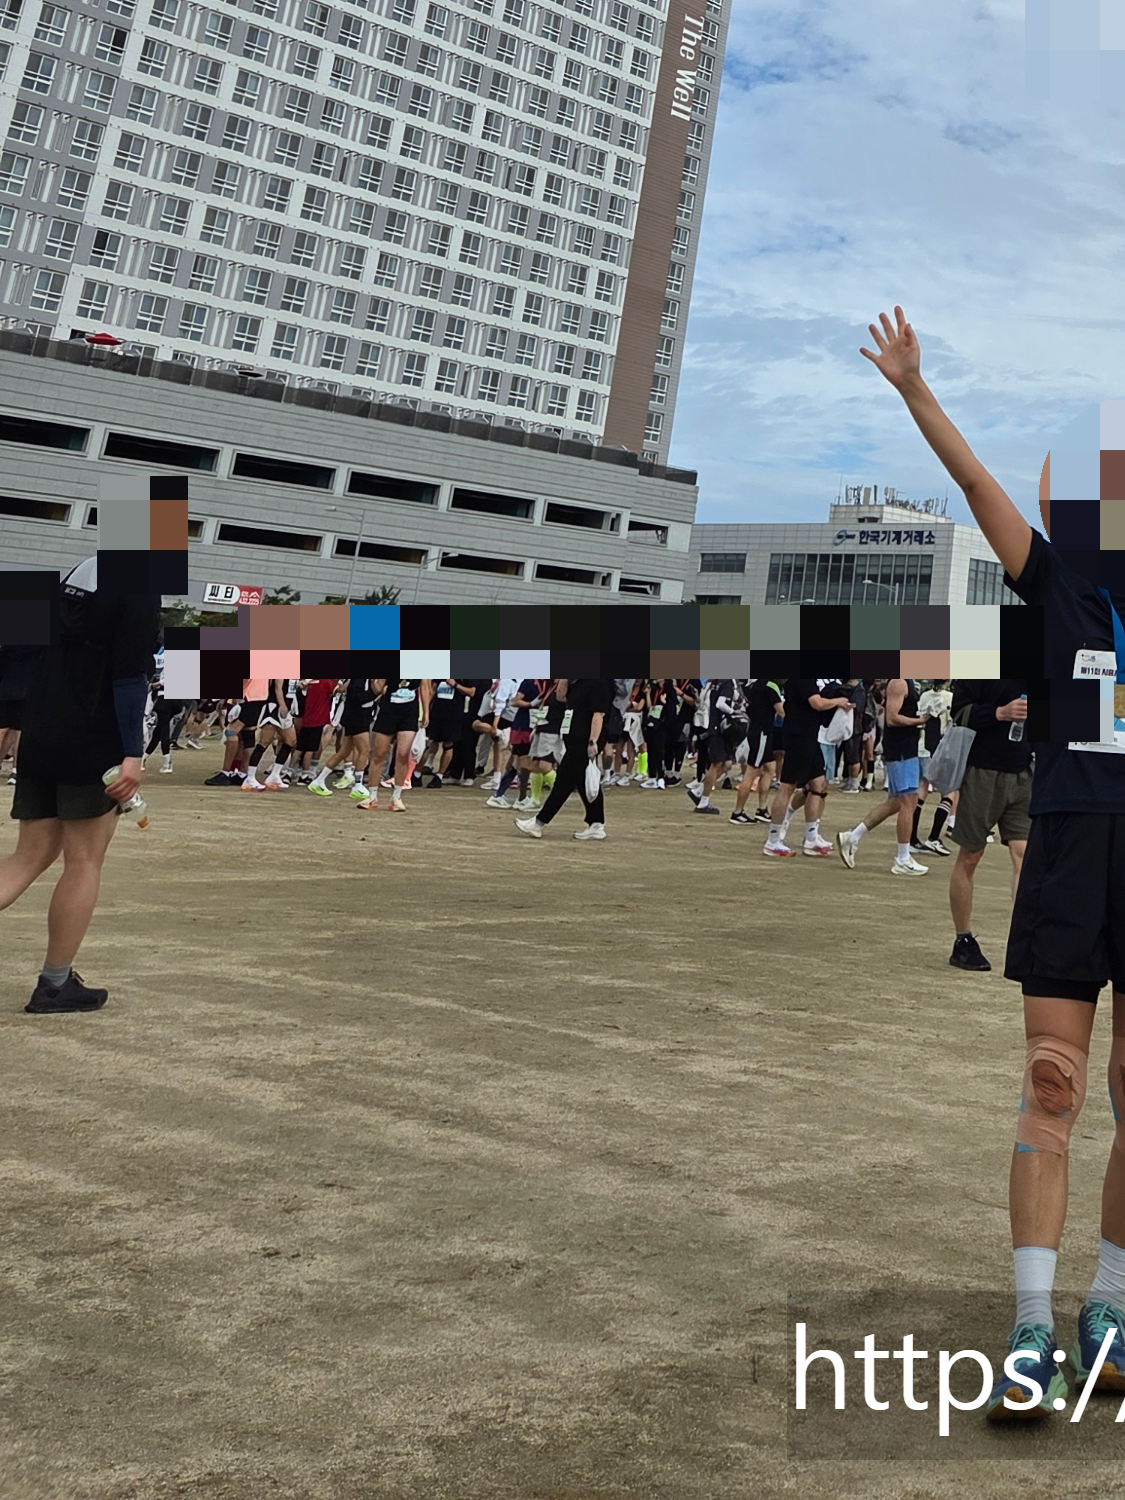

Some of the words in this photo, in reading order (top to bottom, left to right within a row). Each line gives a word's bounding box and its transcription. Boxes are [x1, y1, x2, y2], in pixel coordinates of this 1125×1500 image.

[680, 14, 704, 60] The
[672, 70, 697, 121] Well
[859, 530, 935, 545] 한국기계거래소
